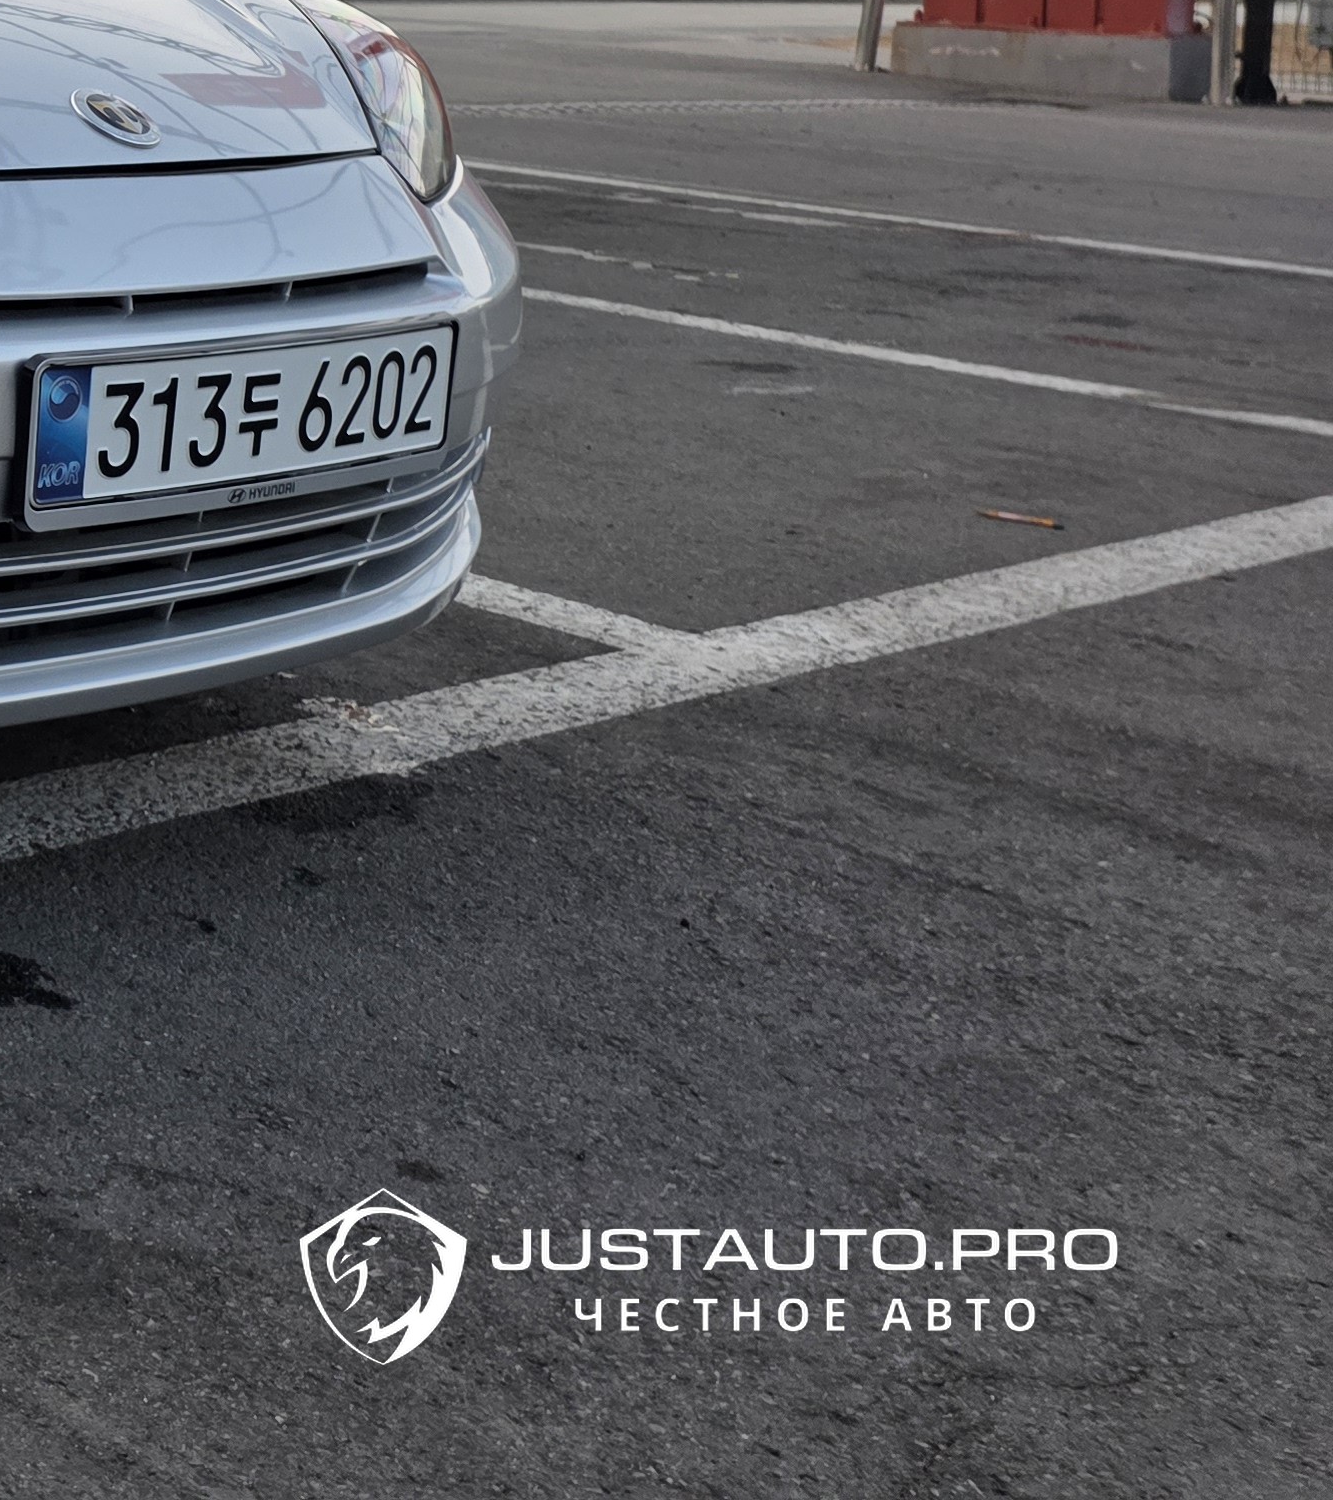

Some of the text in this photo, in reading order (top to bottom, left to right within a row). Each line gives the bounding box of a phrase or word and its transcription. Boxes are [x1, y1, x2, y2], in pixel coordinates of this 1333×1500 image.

[98, 345, 438, 478] 313두 6202
[37, 461, 81, 489] KOR
[248, 482, 296, 500] HYUNDAI
